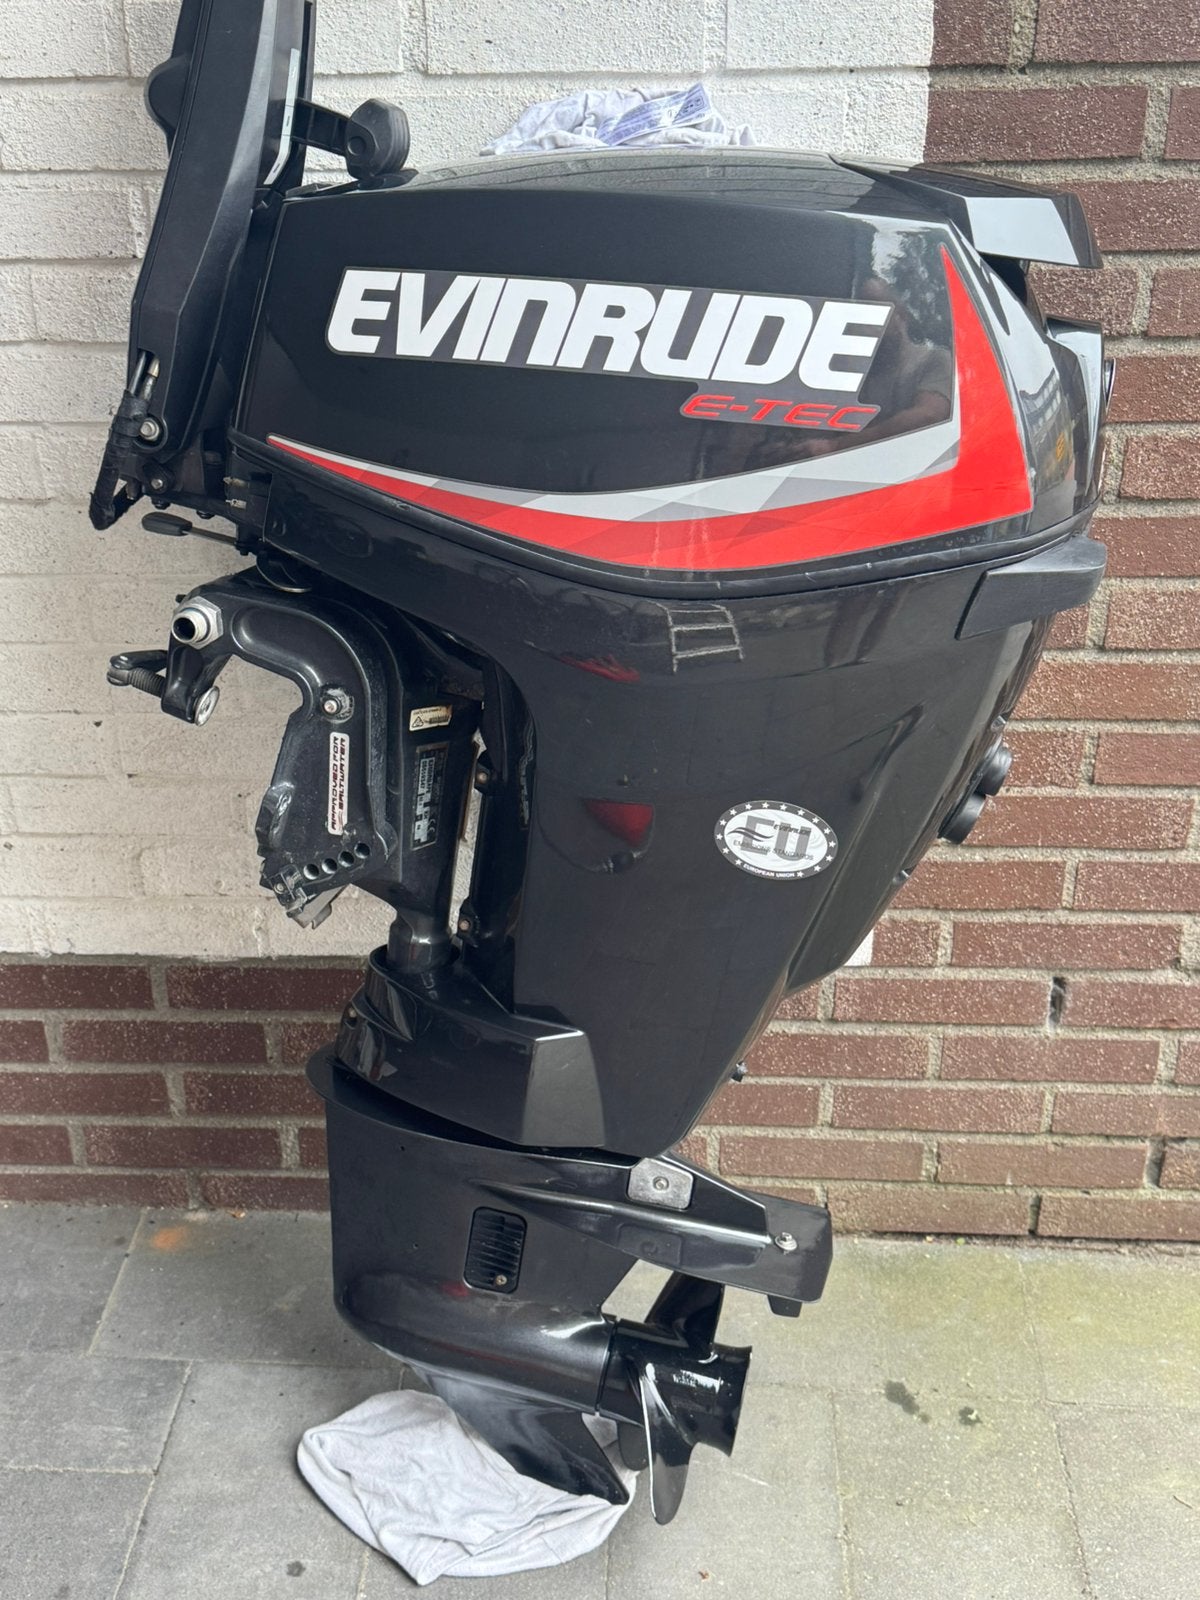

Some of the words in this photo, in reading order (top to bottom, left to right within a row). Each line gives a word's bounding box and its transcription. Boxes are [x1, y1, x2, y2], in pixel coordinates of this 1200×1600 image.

[327, 269, 893, 392] EVINRUDE
[682, 394, 880, 430] E-TEC
[338, 737, 346, 810] SALTWATER
[741, 816, 811, 860] EU
[743, 864, 774, 876] EUROPEAN
